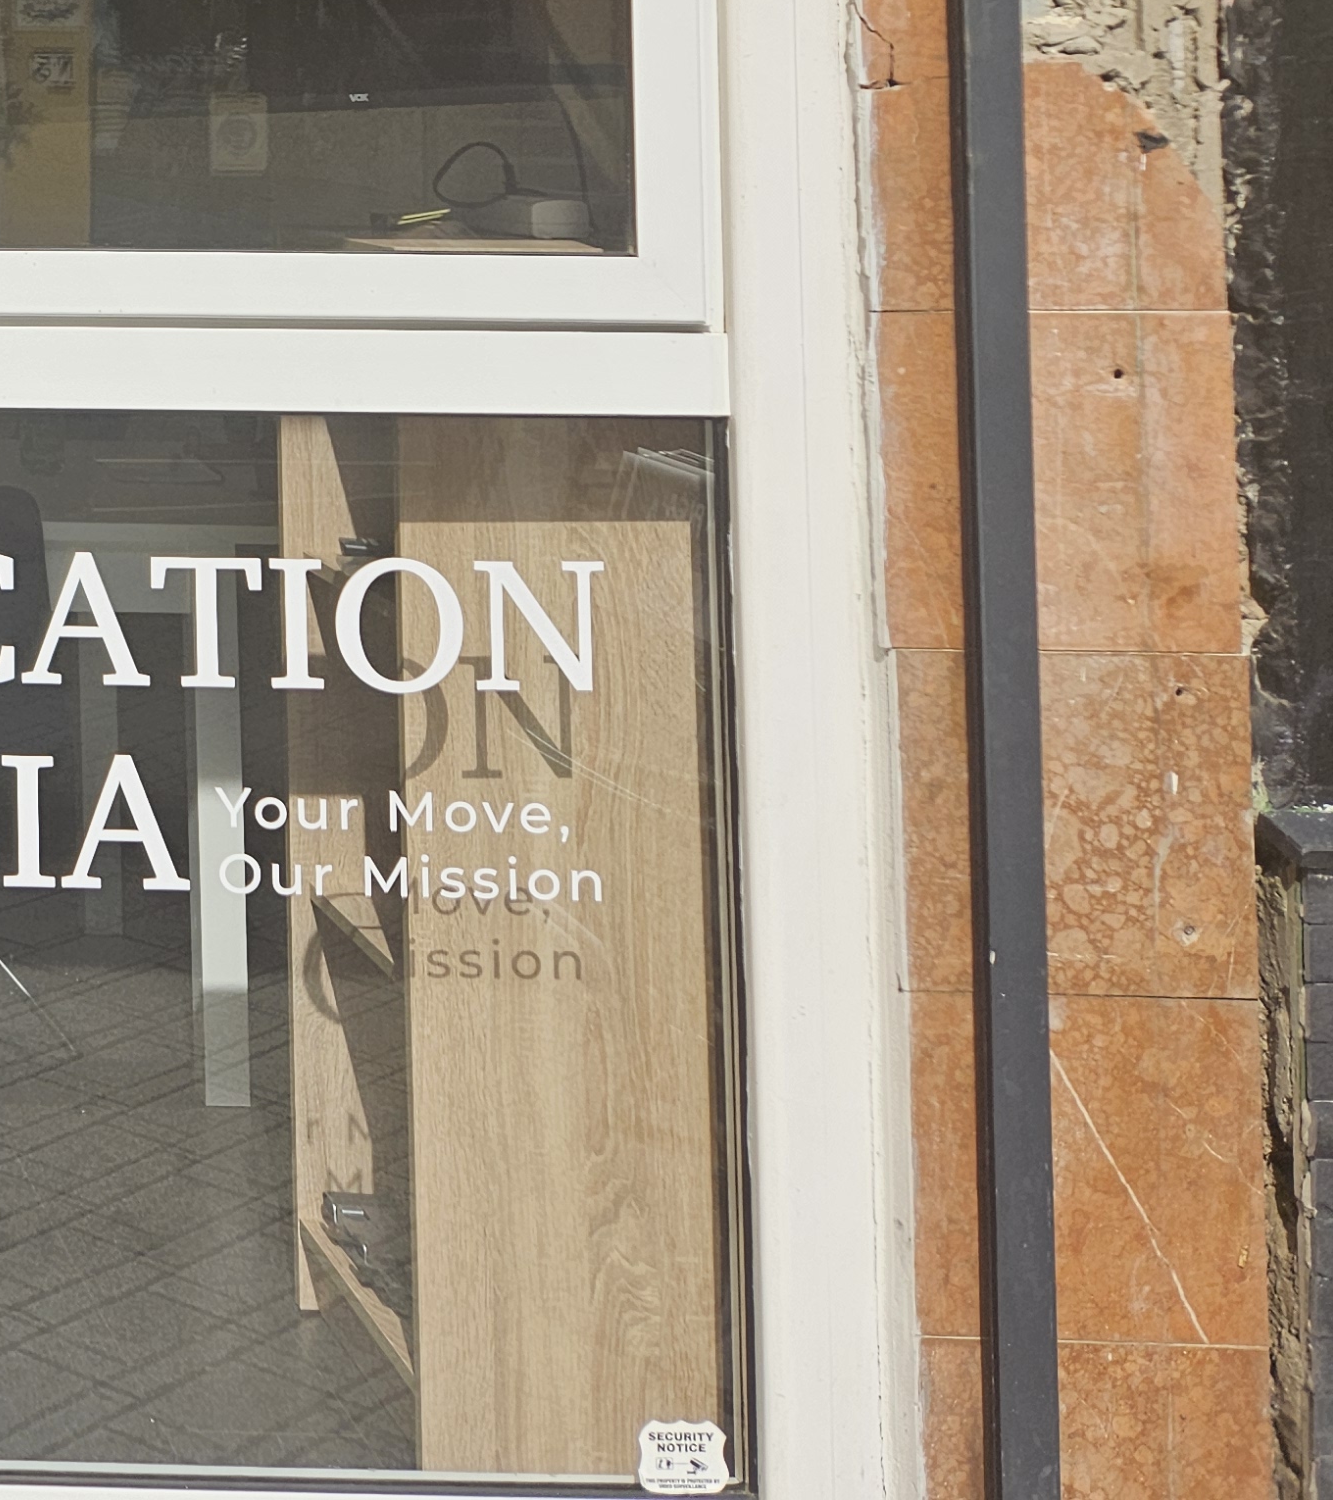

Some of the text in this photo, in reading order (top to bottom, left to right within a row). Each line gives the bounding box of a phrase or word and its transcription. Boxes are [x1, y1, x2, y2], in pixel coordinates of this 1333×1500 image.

[214, 786, 571, 841] Your Move,
[218, 853, 604, 905] Our Mission
[648, 1432, 714, 1441] SECURITY
[657, 1443, 707, 1452] NOTICE
